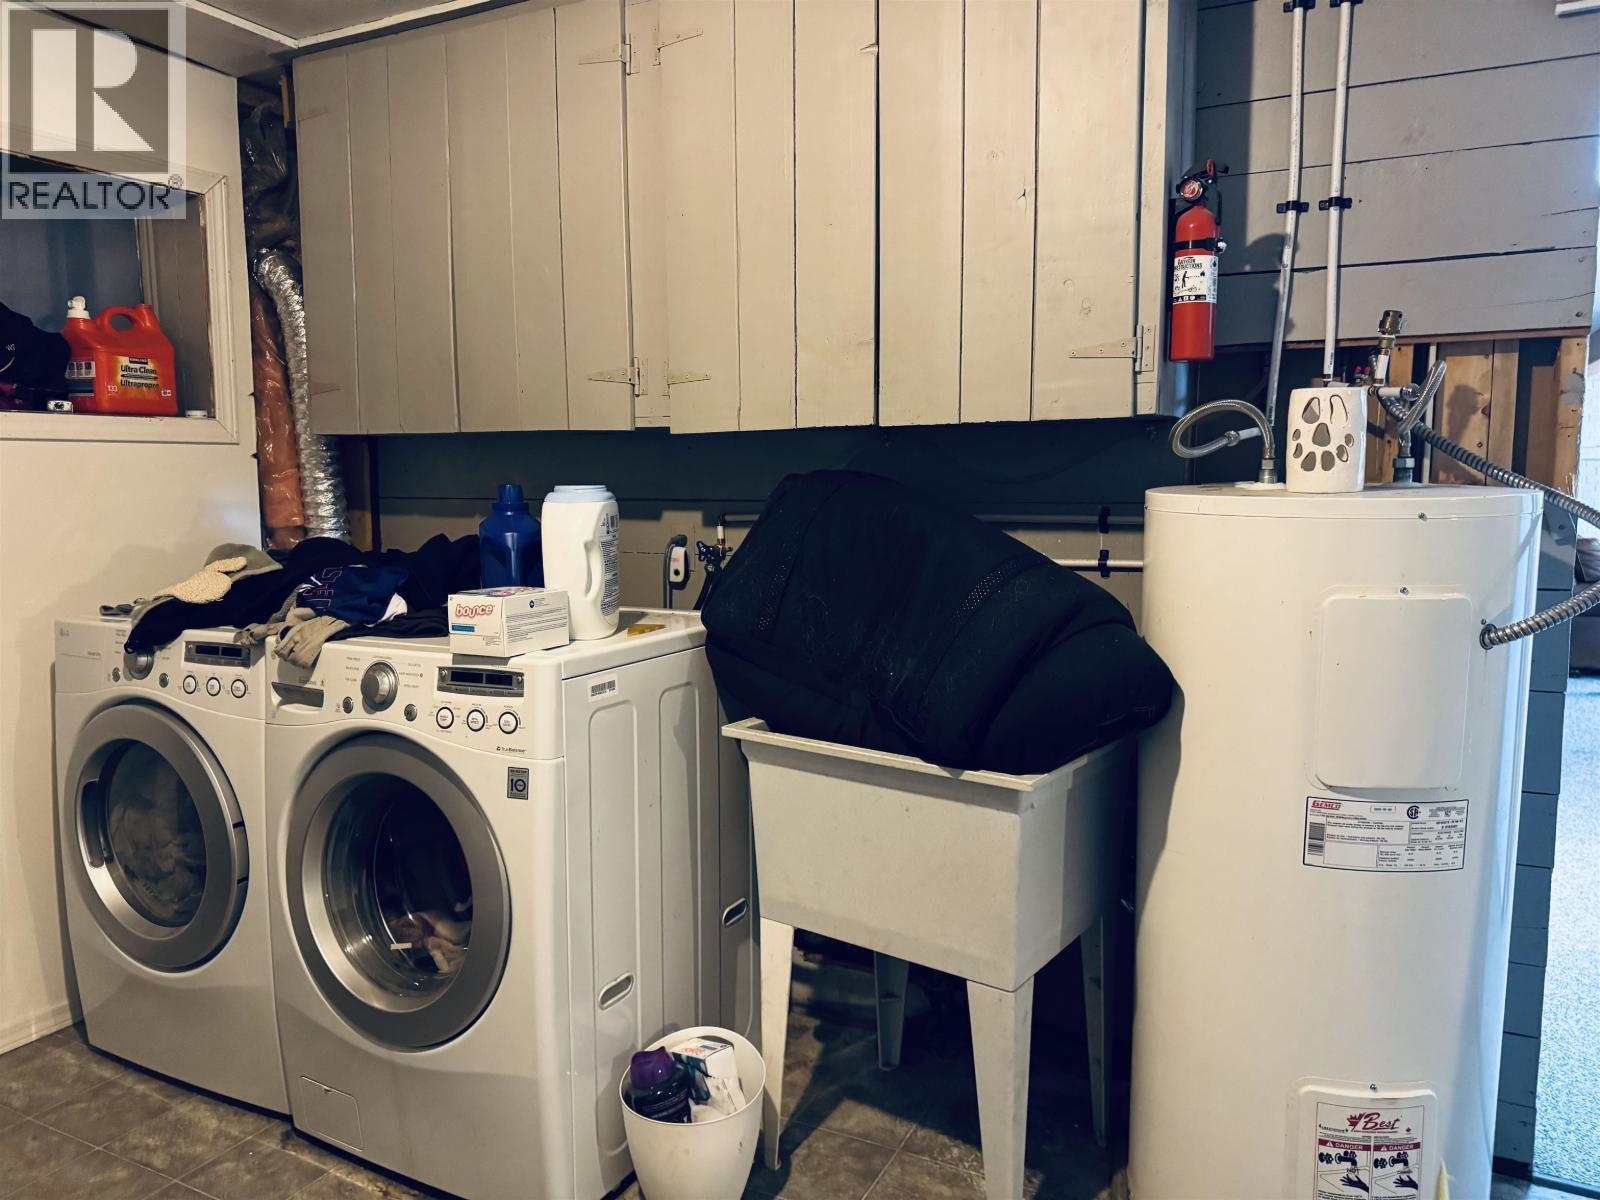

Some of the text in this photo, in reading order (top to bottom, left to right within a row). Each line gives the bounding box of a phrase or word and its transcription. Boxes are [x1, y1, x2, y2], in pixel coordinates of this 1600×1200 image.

[120, 364, 157, 375] Ultra Clean
[455, 603, 495, 619] bounce
[1361, 1112, 1400, 1131] Best
